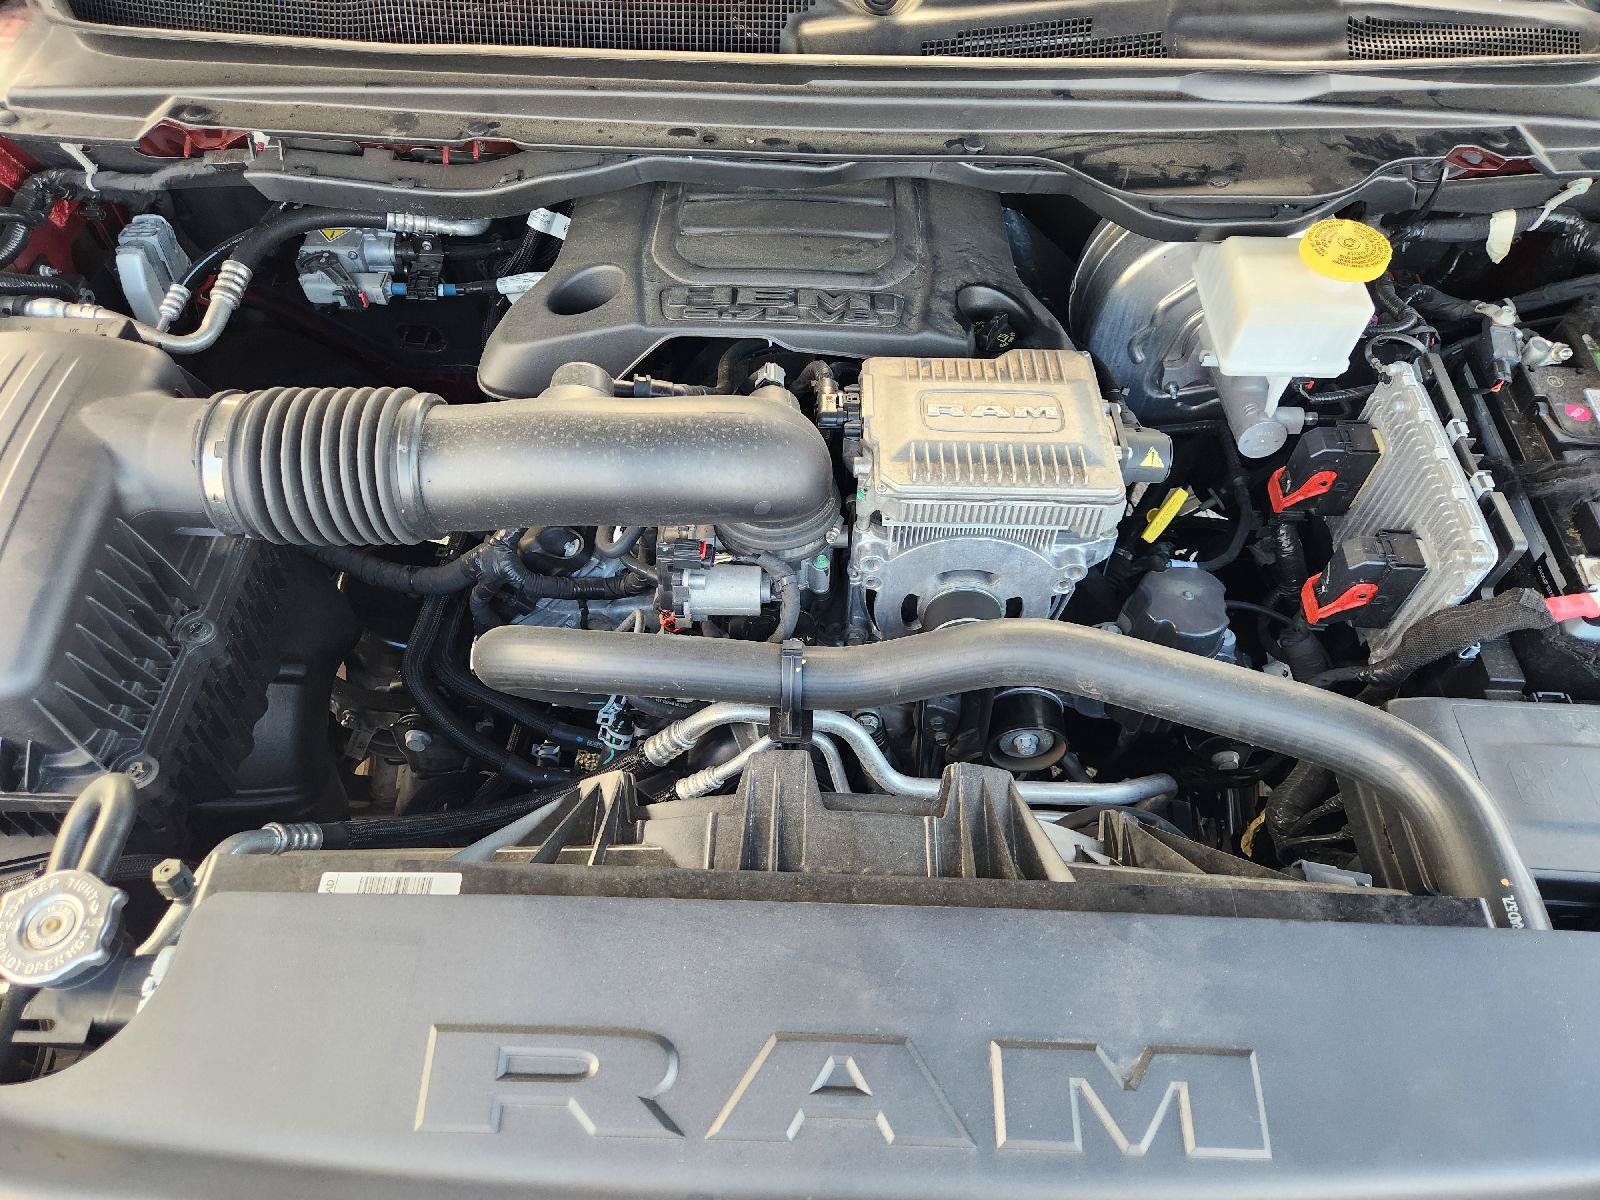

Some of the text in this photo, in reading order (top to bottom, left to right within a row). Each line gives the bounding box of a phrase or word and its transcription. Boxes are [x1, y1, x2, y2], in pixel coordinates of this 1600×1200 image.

[667, 286, 900, 312] HEMI
[927, 403, 1059, 419] RAM
[410, 1023, 1275, 1162] RAM
